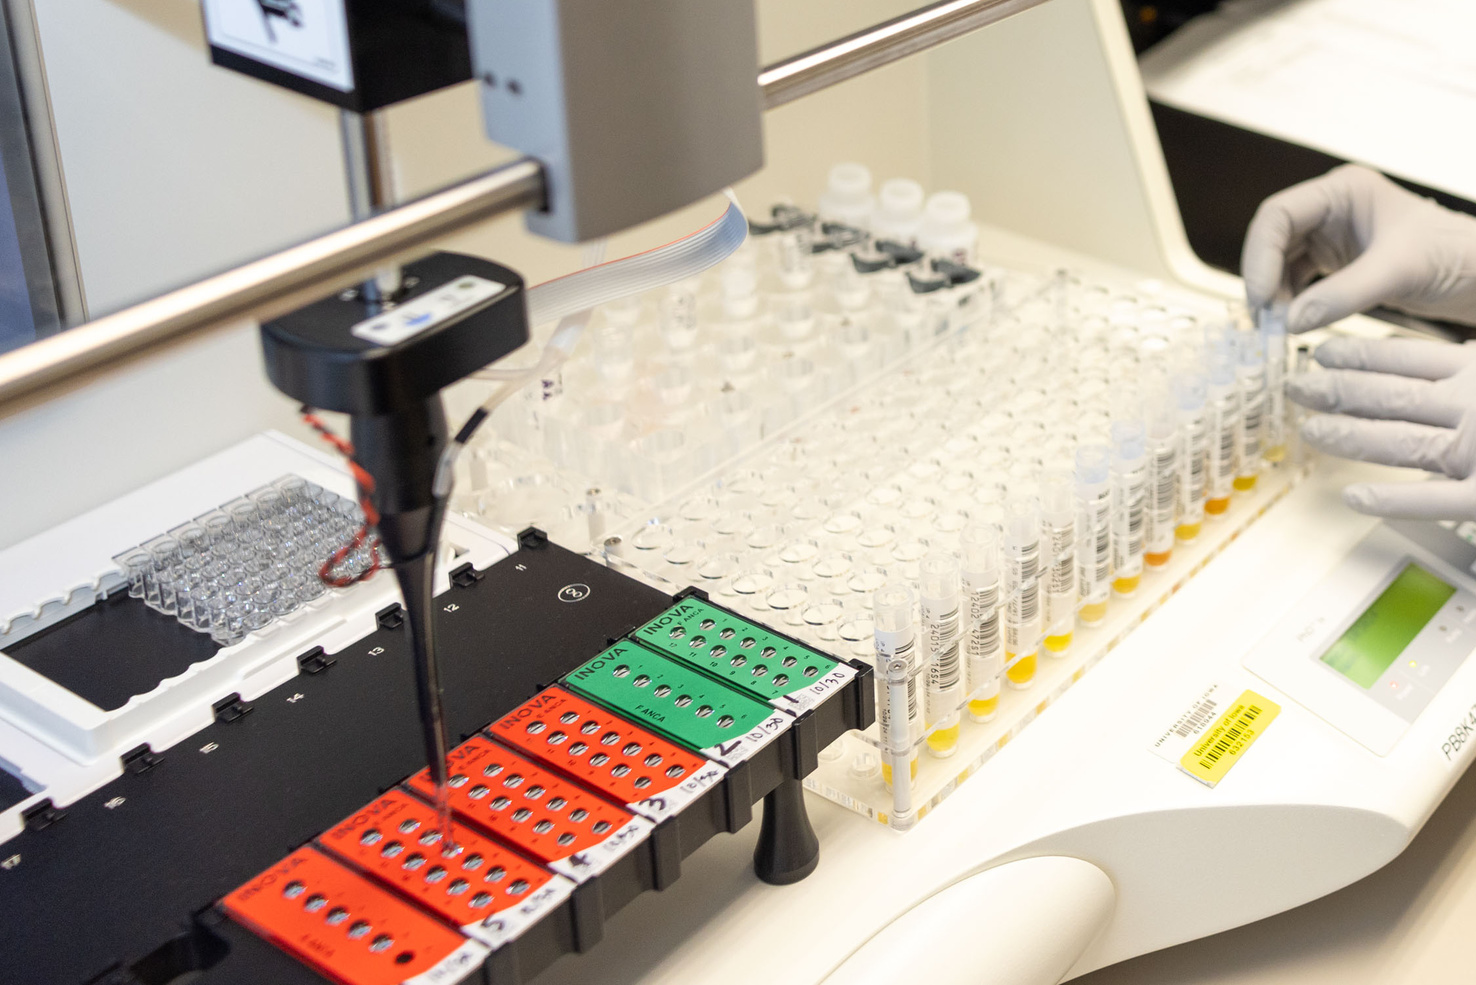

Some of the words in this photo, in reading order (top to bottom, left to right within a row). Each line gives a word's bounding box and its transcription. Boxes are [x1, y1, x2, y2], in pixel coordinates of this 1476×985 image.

[514, 563, 527, 572] 11
[443, 603, 460, 613] 12
[643, 604, 694, 635] INOVA
[368, 646, 385, 657] 13
[574, 646, 628, 680] INOVA
[809, 672, 845, 695] 10/30
[286, 692, 304, 704] 14
[499, 695, 557, 729] INOVA
[745, 717, 783, 742] 10/30
[1154, 710, 1192, 748] UNIVERSITY
[1193, 725, 1226, 757] University
[1229, 704, 1245, 720] Iowa
[199, 741, 219, 754] 15
[714, 740, 742, 756] 2
[1228, 729, 1255, 756] 632153
[103, 796, 127, 810] 16
